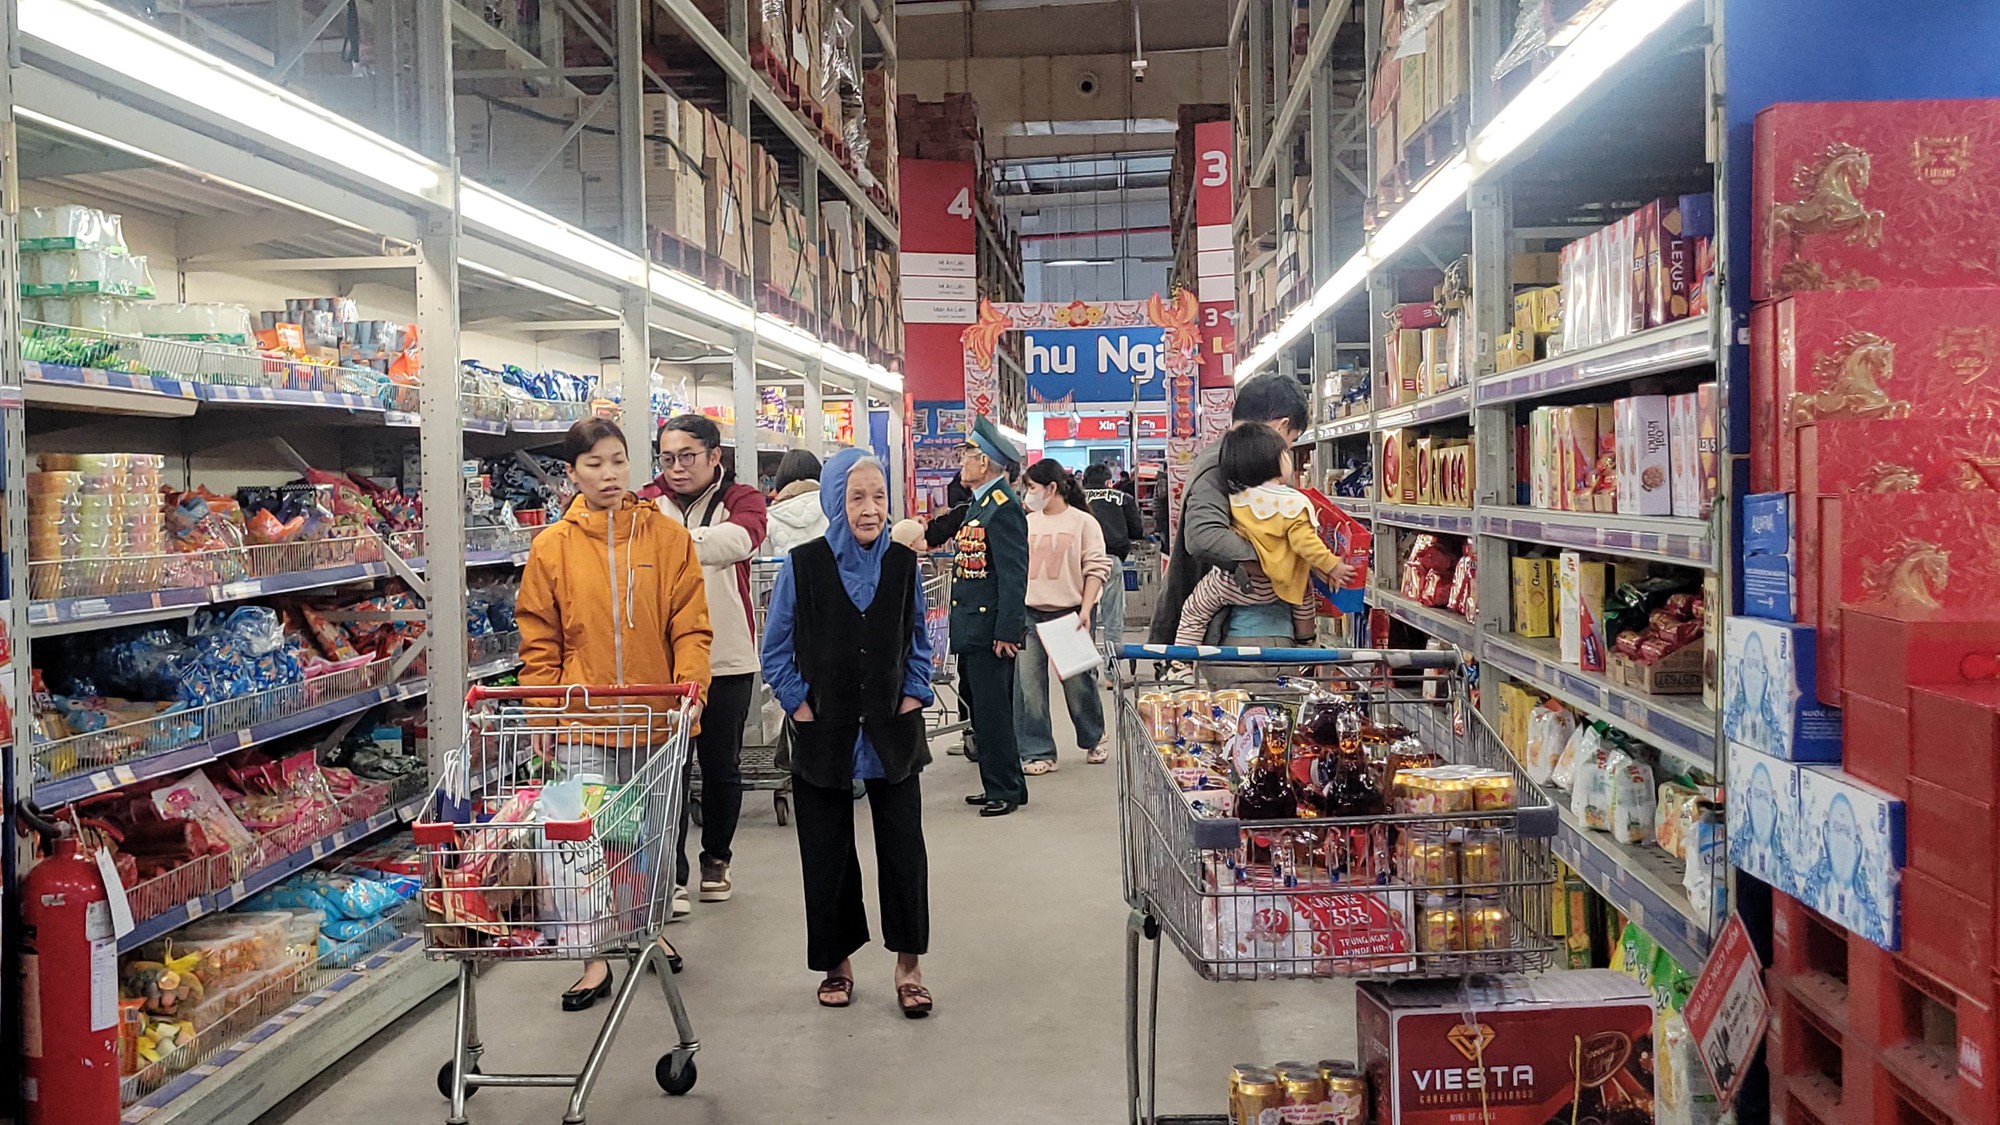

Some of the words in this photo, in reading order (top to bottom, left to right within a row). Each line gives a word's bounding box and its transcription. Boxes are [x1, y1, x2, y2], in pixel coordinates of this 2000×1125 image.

[1202, 150, 1228, 187] 3
[947, 187, 972, 219] 4
[1671, 240, 1684, 292] LEXUS
[1099, 420, 1115, 430] Xin
[1326, 907, 1373, 927] 333
[1412, 1065, 1534, 1091] VIESTA
